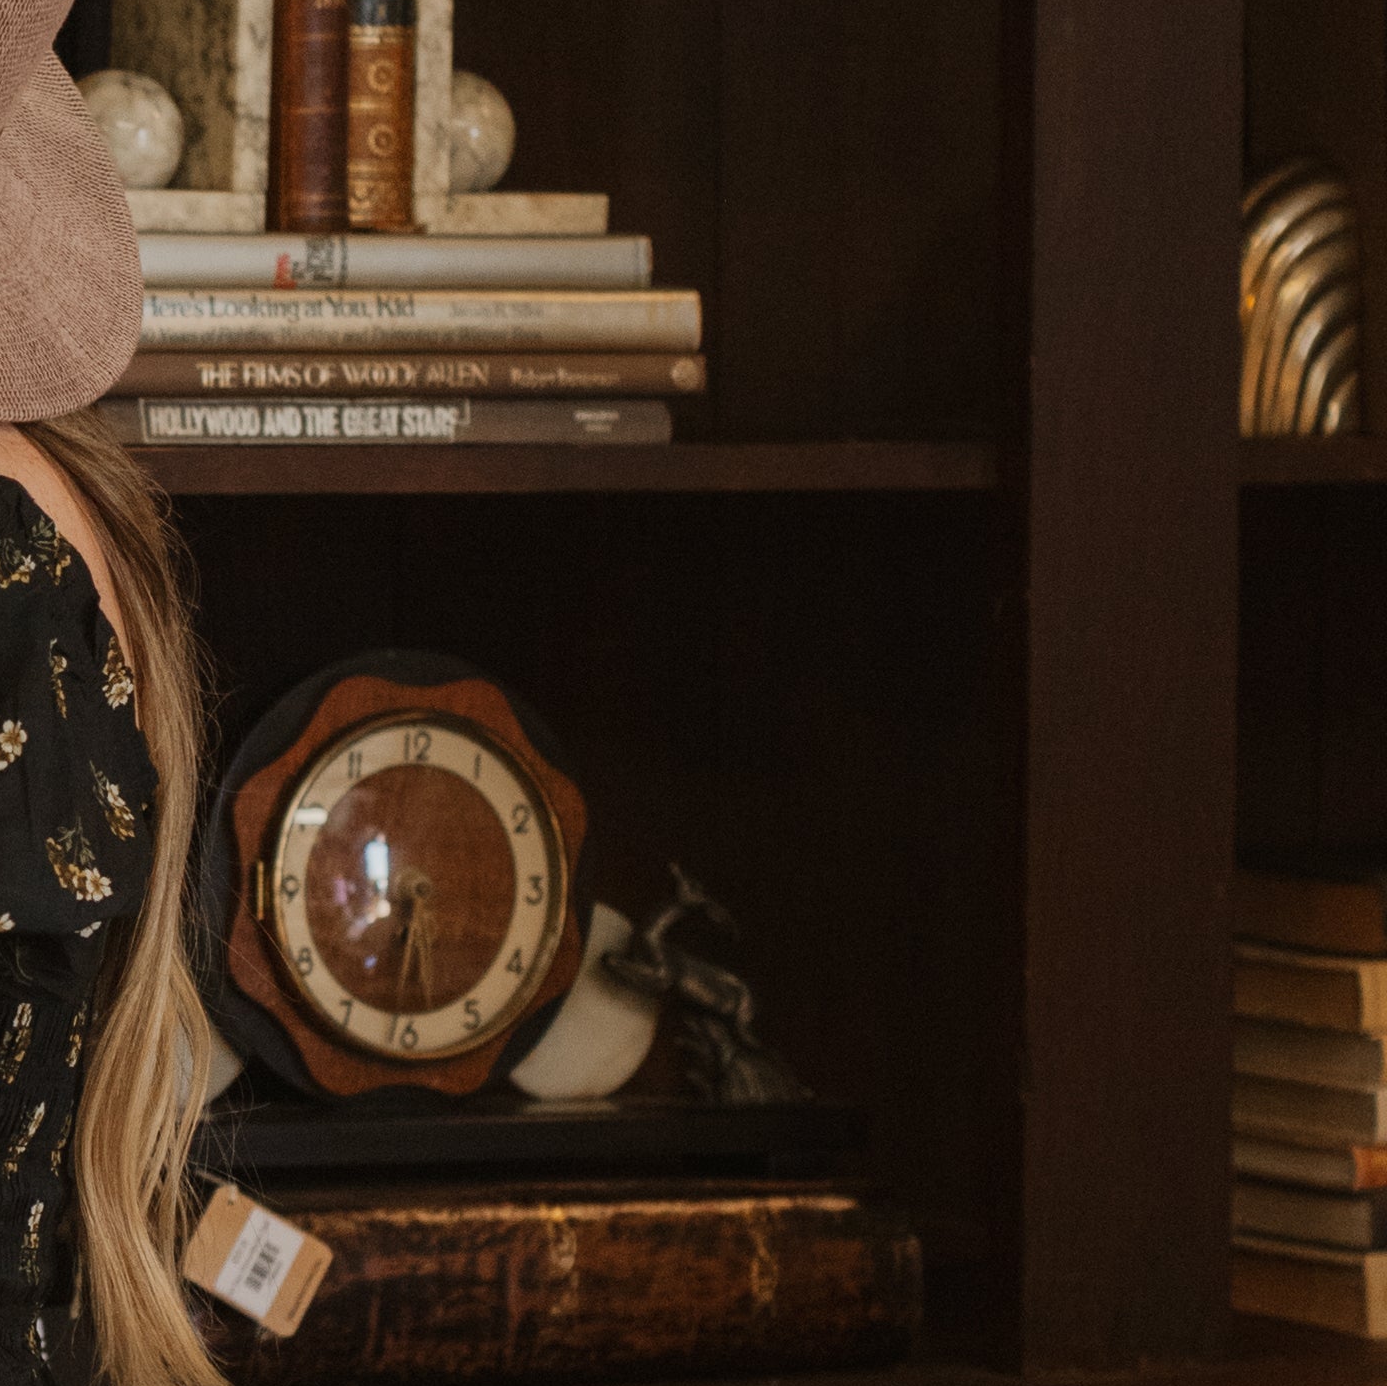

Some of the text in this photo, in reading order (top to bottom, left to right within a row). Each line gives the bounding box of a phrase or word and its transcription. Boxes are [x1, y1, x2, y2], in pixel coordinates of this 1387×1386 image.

[209, 294, 300, 323] Looking
[303, 298, 324, 318] at
[325, 294, 372, 321] You,
[376, 294, 415, 318] Kid
[196, 361, 490, 388] THE FILMS OF WOODY ALLEN
[148, 405, 459, 441] HOLLYWOOD AND THE GREAT STARS
[403, 730, 432, 763] 12
[512, 803, 529, 834] 2
[282, 874, 300, 903] 9
[525, 874, 543, 905] 3
[297, 947, 314, 976] 8
[506, 948, 524, 975] 4
[338, 999, 355, 1029] 7
[463, 999, 481, 1030] 5
[399, 1021, 419, 1049] 6
